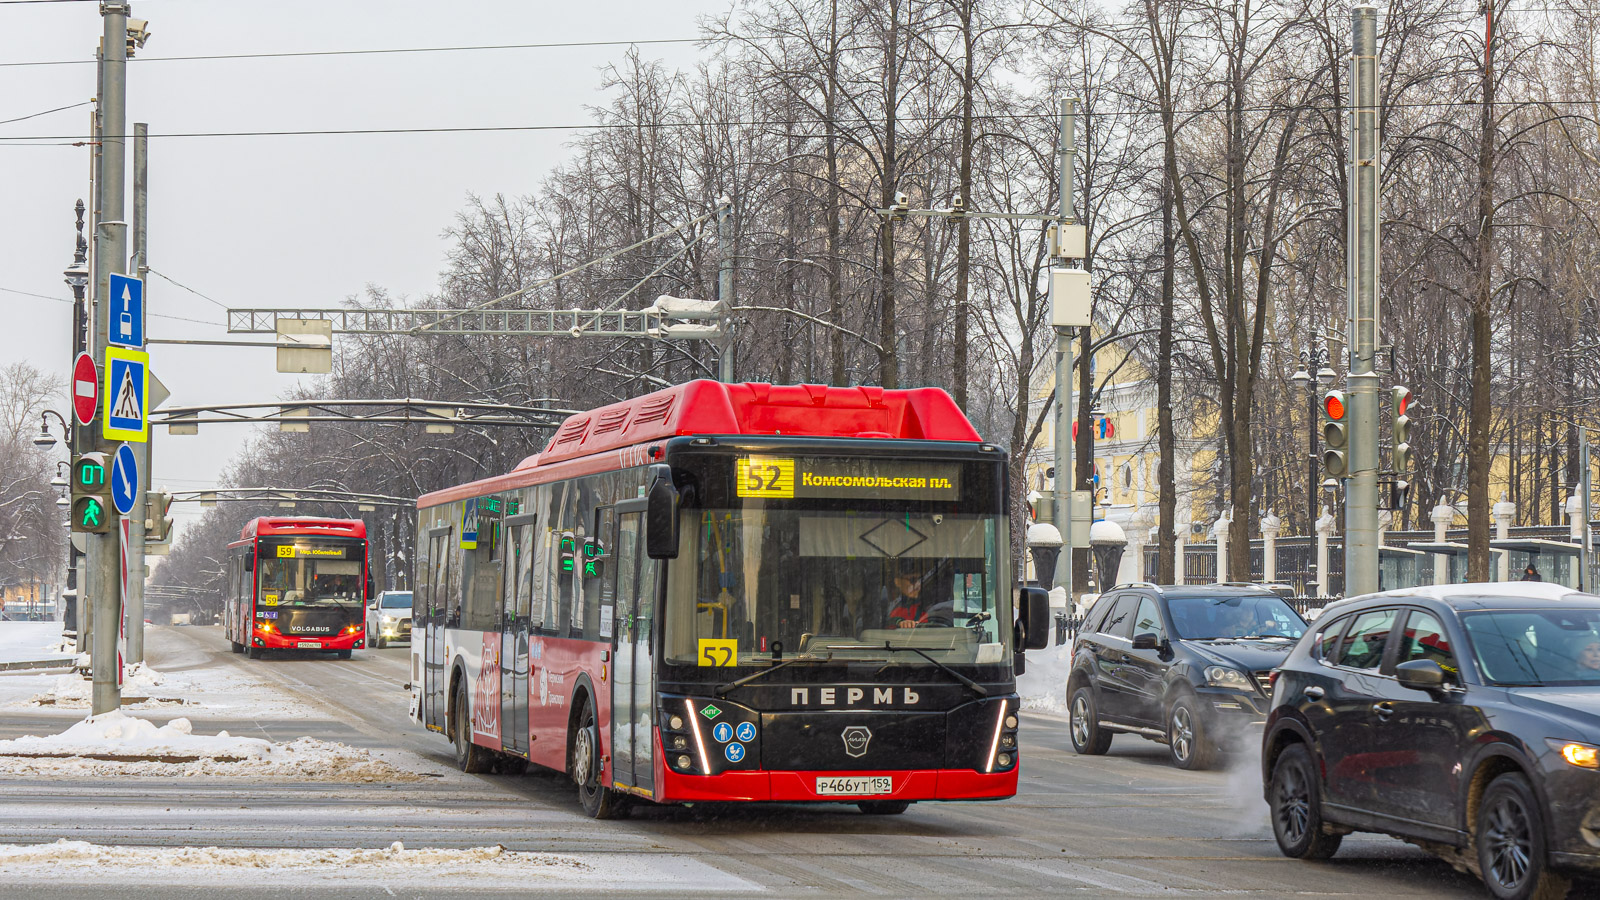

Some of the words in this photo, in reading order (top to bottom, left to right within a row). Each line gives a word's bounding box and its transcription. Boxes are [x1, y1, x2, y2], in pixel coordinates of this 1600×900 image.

[82, 465, 104, 484] 07
[747, 465, 782, 491] 52
[802, 472, 926, 488] Комсомольская
[929, 477, 952, 489] пл.
[280, 547, 292, 556] 59
[266, 597, 277, 605] 59
[703, 646, 733, 667] 52
[791, 687, 920, 705] ПЕРМЬ
[870, 778, 889, 788] 159
